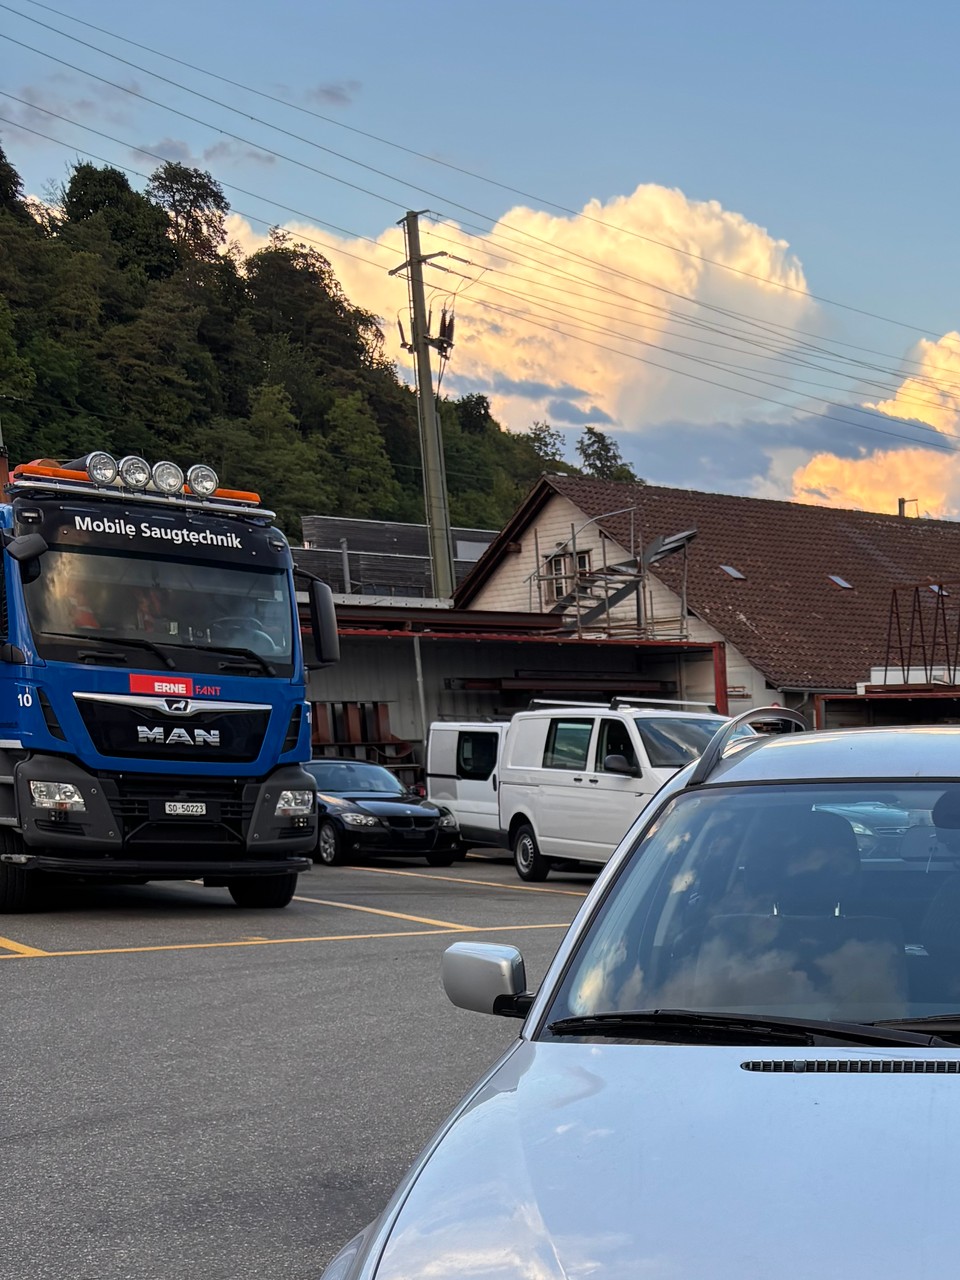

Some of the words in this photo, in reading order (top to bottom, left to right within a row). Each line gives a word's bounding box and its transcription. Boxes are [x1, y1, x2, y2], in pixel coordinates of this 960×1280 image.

[74, 515, 136, 536] Mobile
[141, 523, 243, 549] Saugtechnik
[154, 681, 187, 694] ERNE
[195, 685, 222, 697] FANT
[17, 693, 33, 707] 10
[137, 725, 221, 746] MAN
